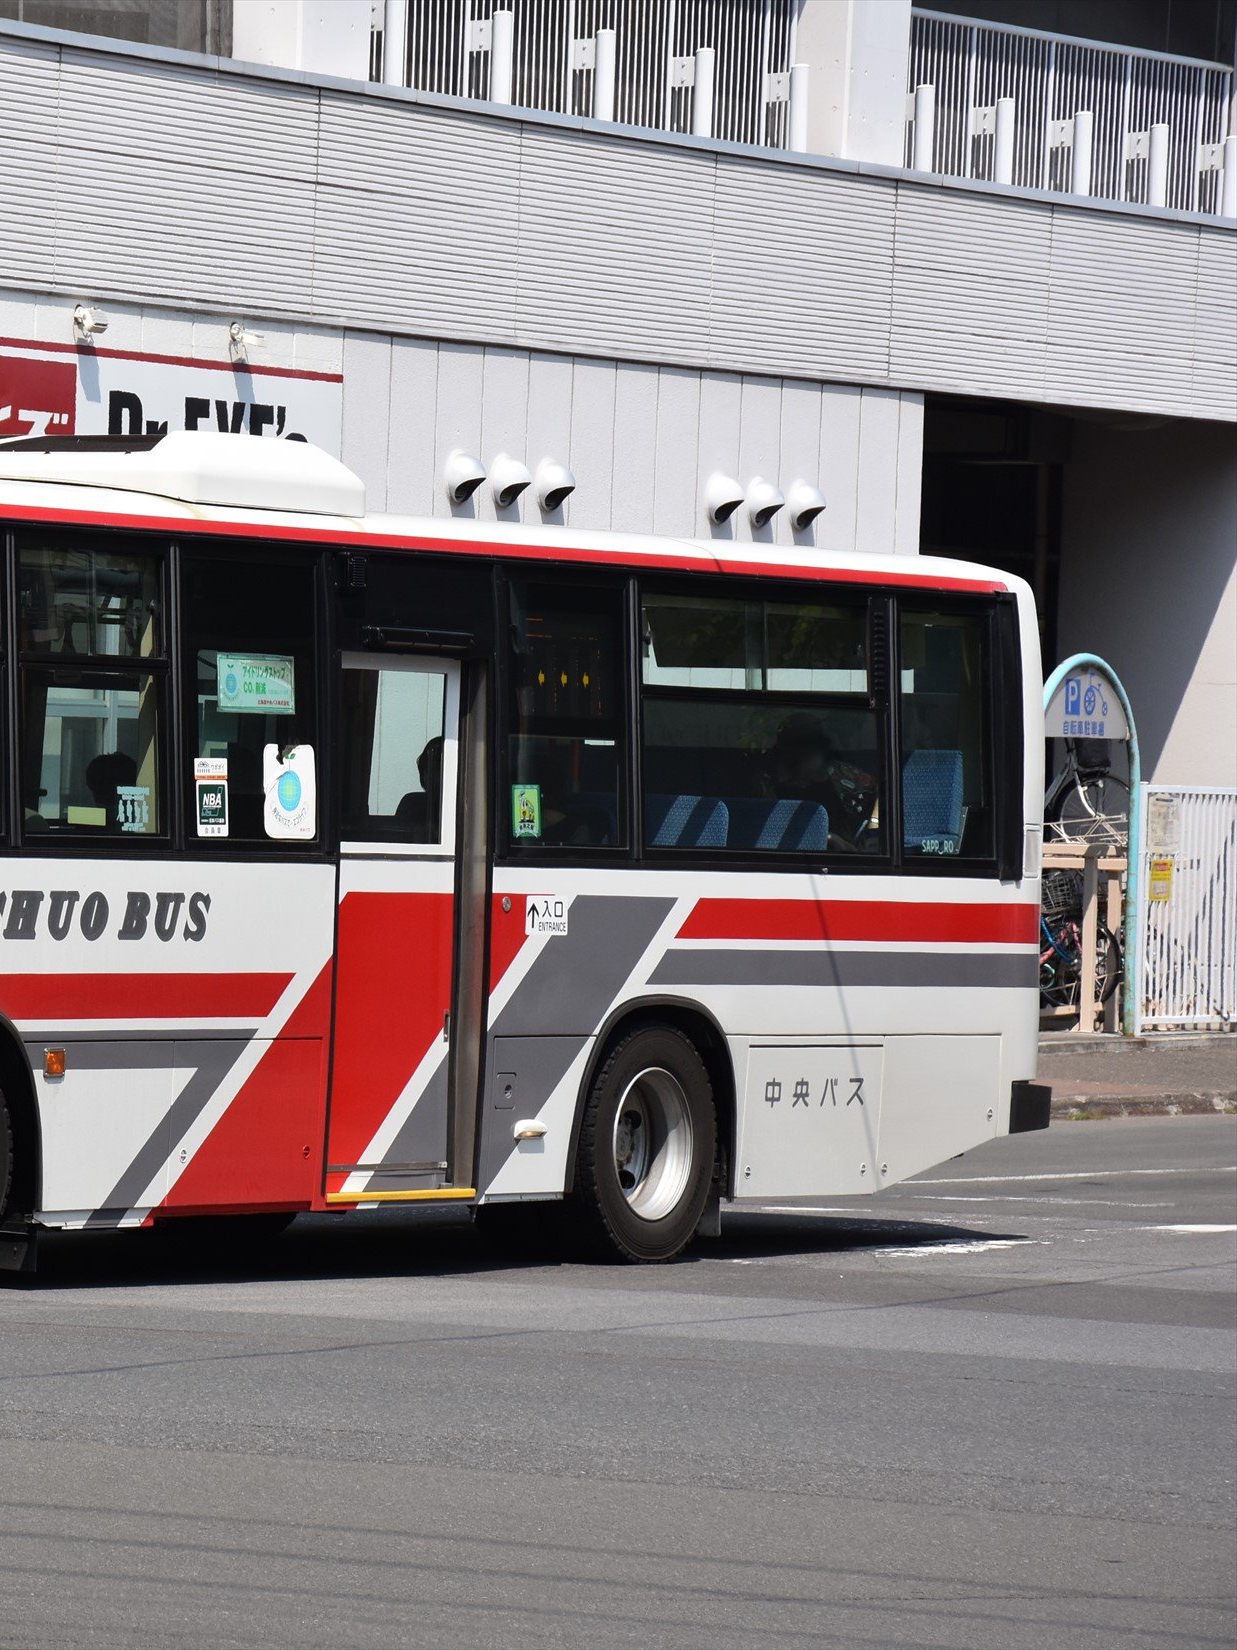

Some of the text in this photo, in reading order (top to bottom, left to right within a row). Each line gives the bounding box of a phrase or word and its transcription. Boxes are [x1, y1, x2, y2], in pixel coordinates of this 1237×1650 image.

[202, 793, 222, 806] NBA
[117, 890, 212, 943] BUS
[542, 900, 564, 918] 入口
[538, 921, 567, 932] ENTRANCE
[764, 1077, 864, 1108] 中央バス
